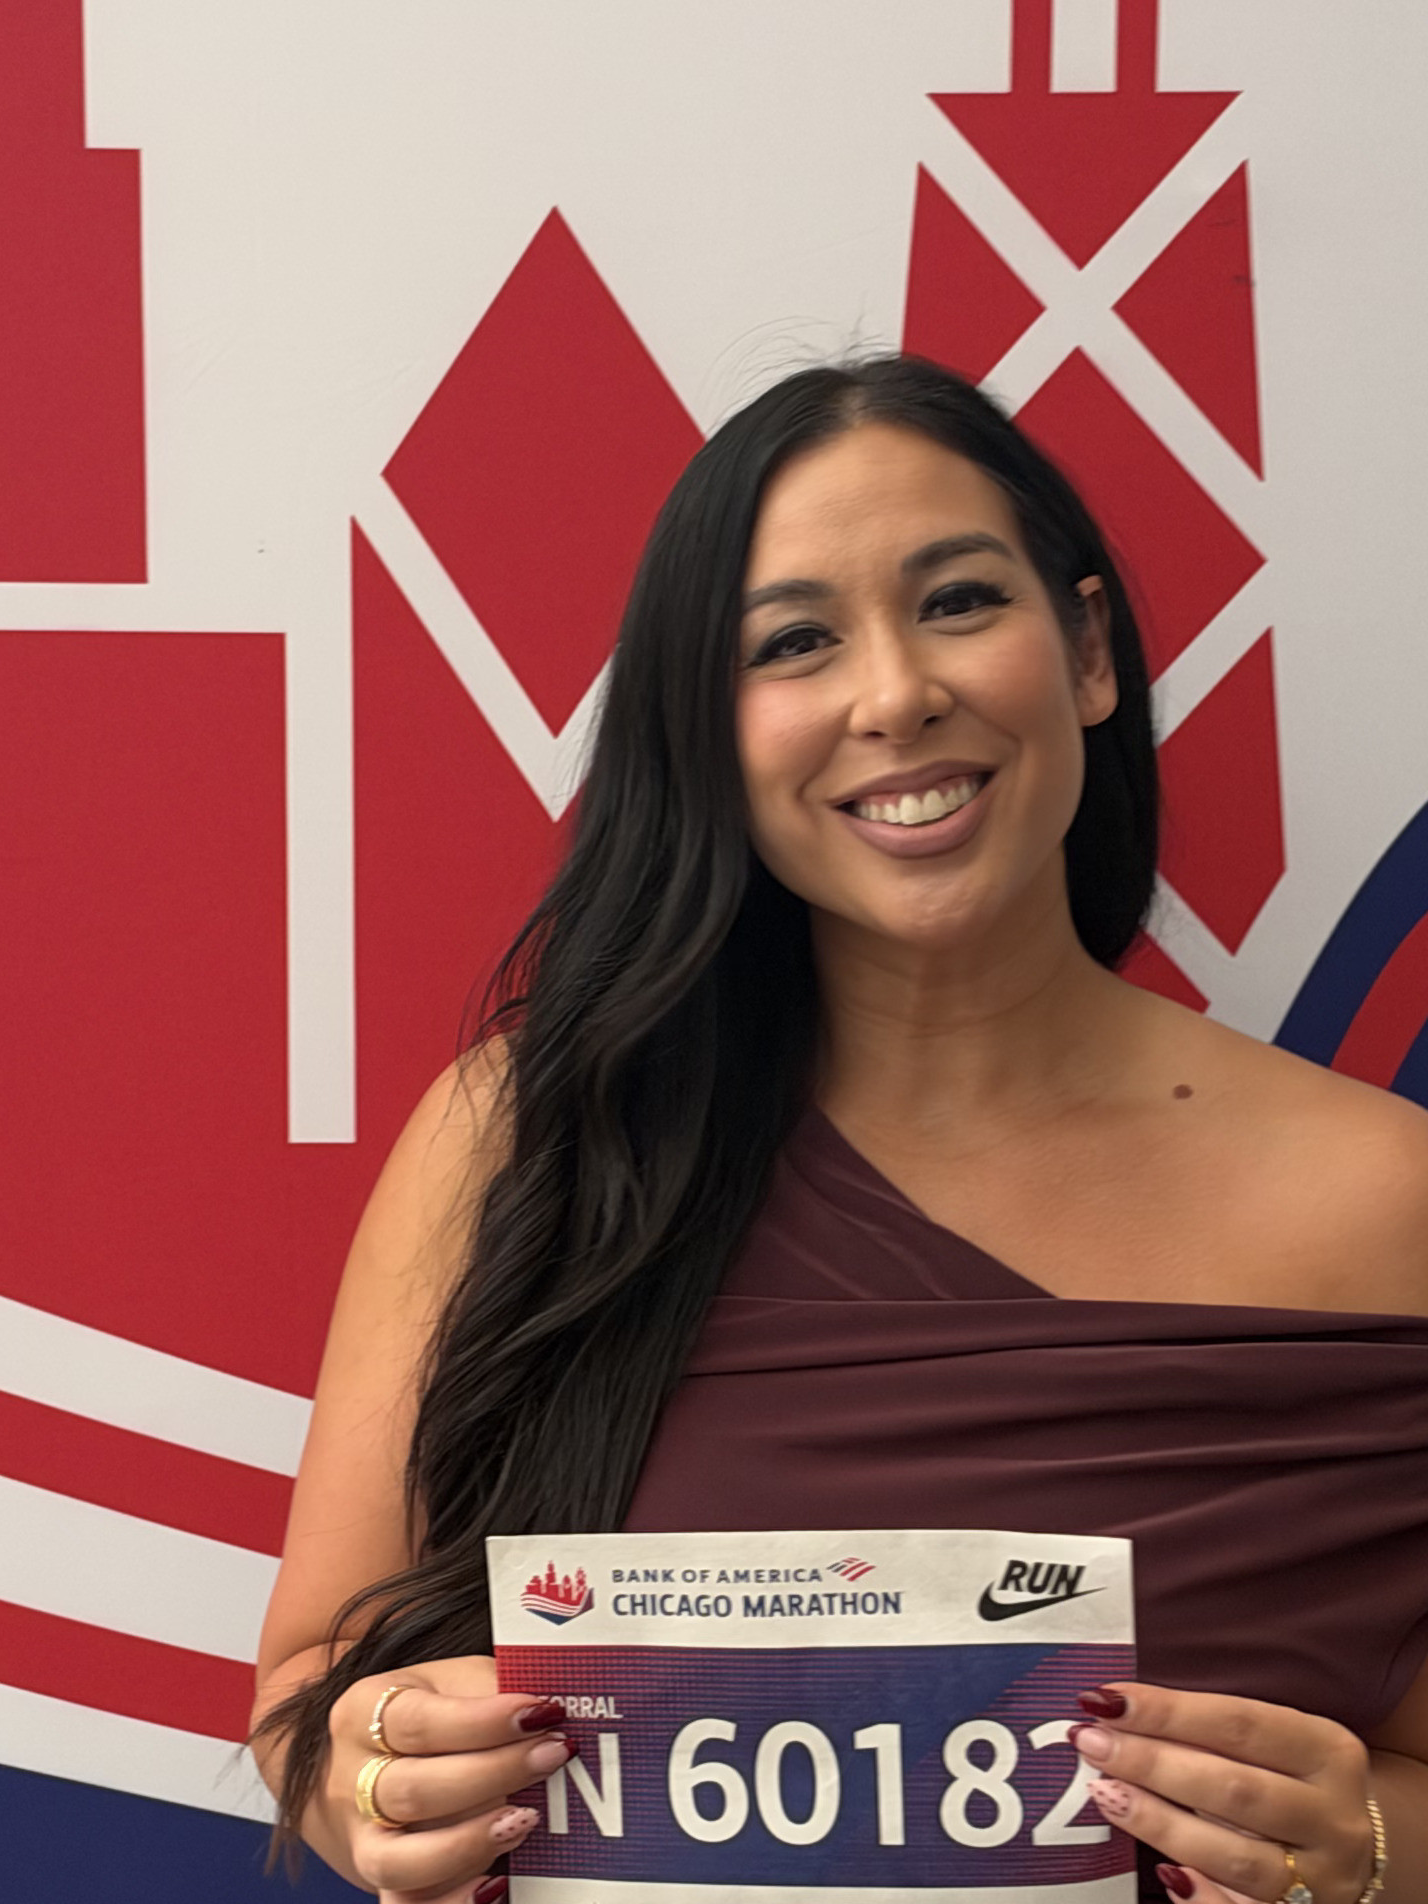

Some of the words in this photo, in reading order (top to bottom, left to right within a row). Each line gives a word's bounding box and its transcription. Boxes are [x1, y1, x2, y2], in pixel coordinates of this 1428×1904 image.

[611, 1568, 676, 1584] BANK
[681, 1568, 711, 1584] OF
[715, 1567, 823, 1584] AMERICA
[997, 1559, 1087, 1597] RUN
[611, 1593, 733, 1618] CHICAGO
[741, 1591, 903, 1618] MARATHON
[540, 1695, 624, 1719] RRAL
[545, 1732, 624, 1838] N
[668, 1717, 1112, 1848] 60182
